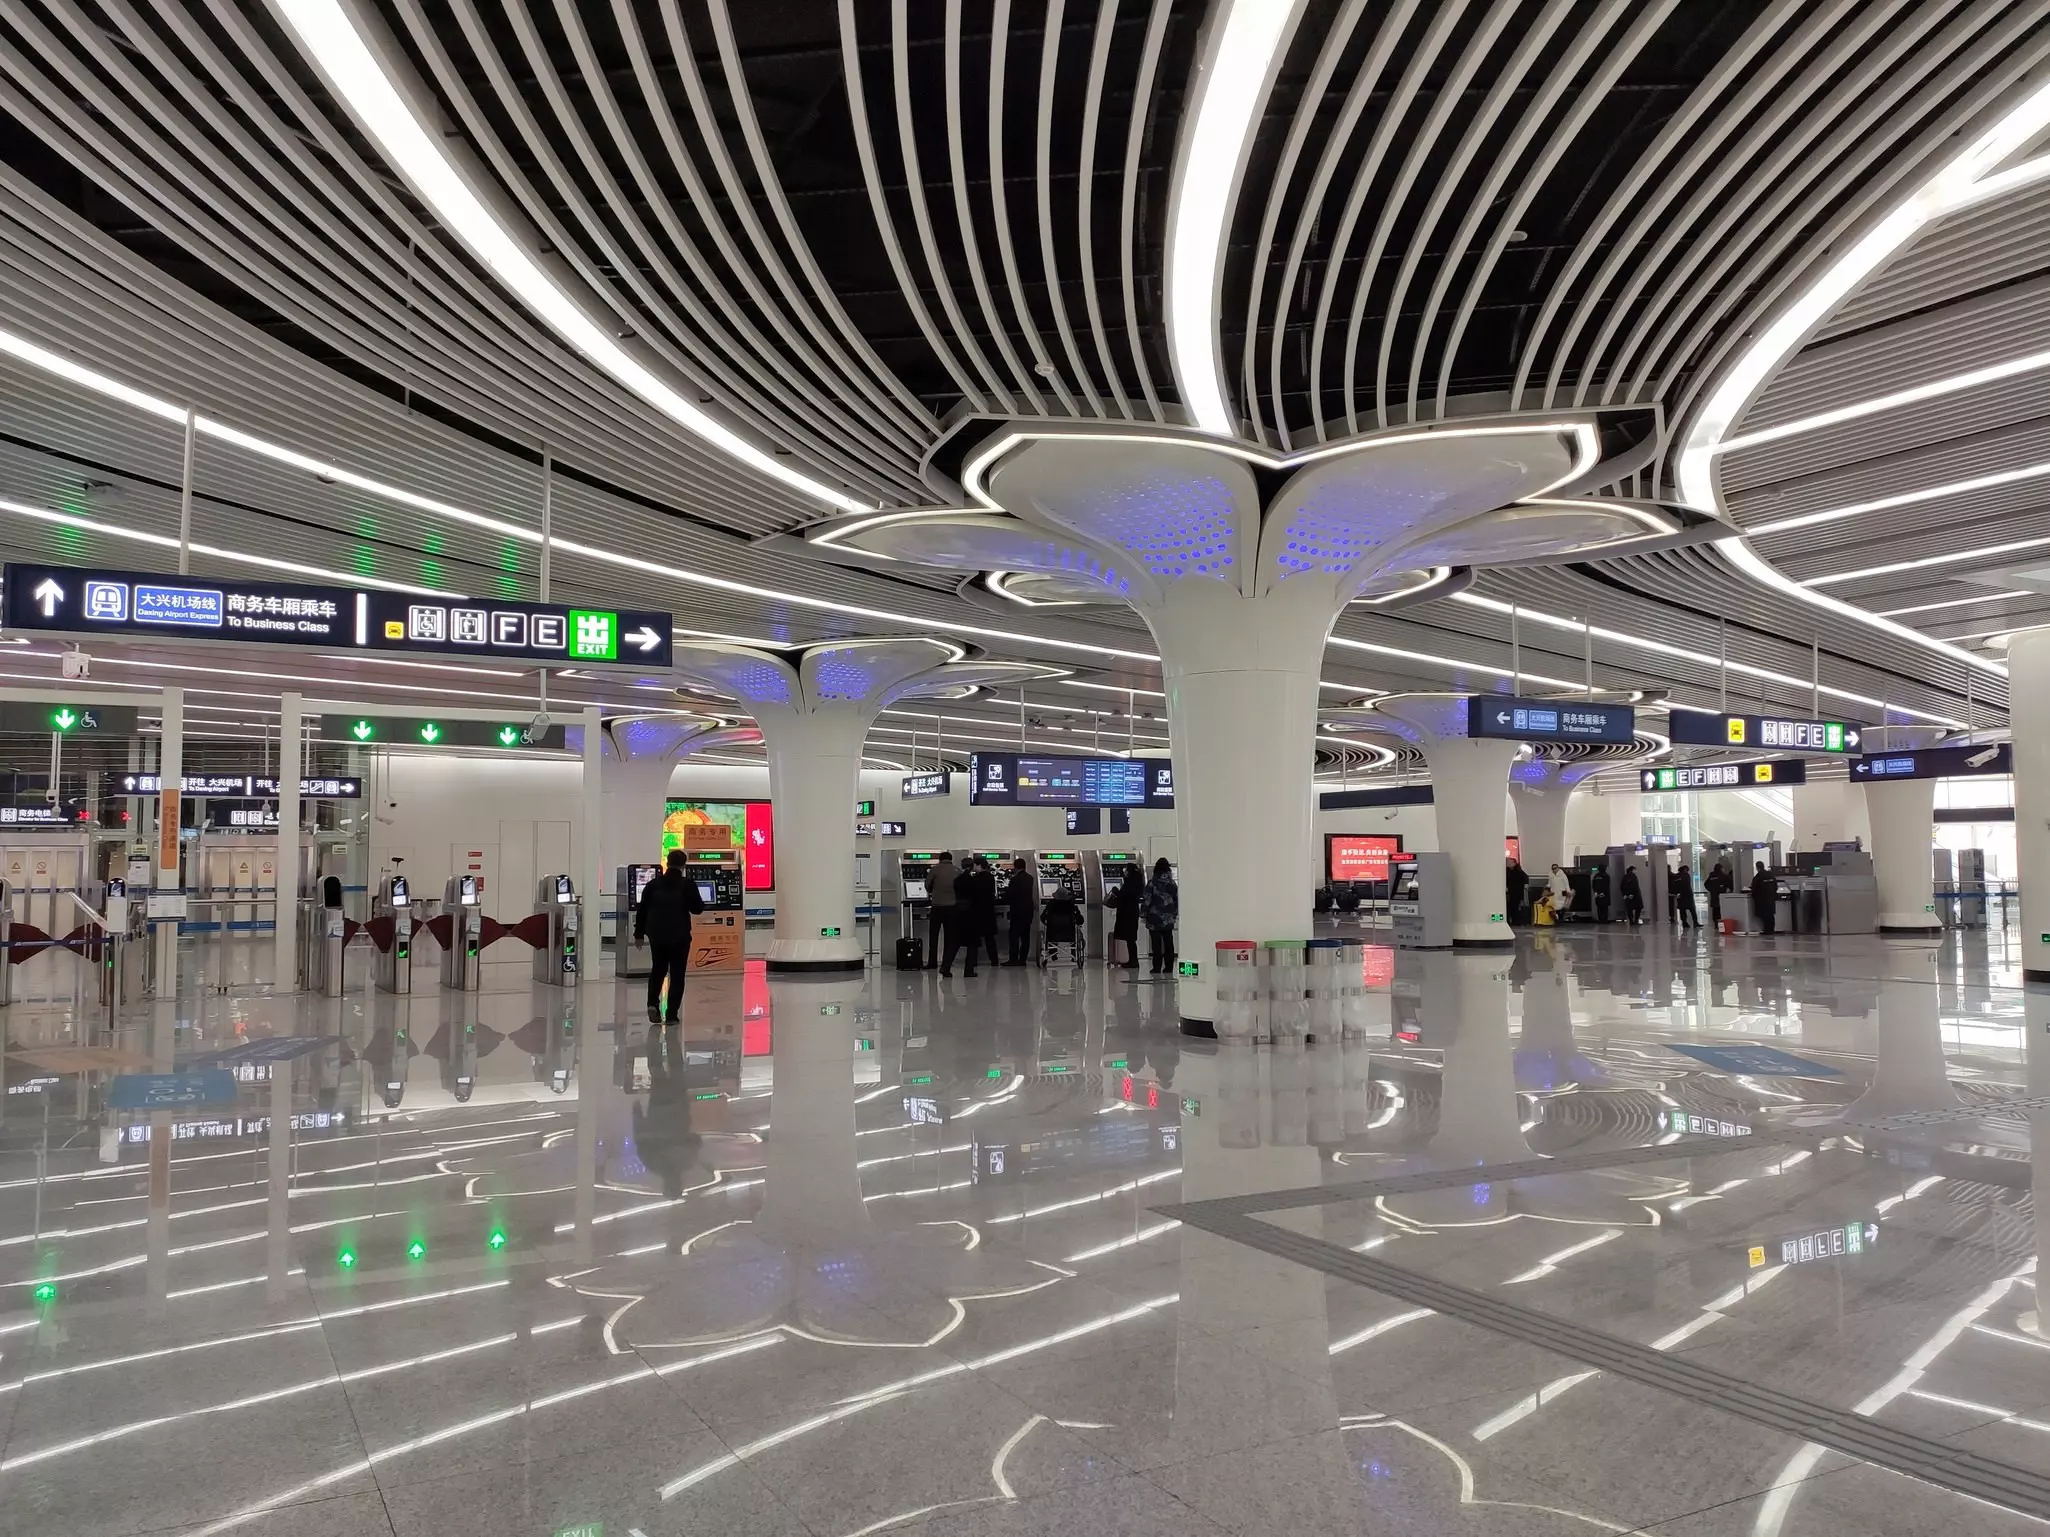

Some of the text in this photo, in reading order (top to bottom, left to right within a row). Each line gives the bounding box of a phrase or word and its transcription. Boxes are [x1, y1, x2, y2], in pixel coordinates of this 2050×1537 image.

[140, 592, 217, 611] 大兴机场线
[227, 593, 338, 619] 商务车厢乘车
[138, 608, 219, 621] Daxing Airport Express
[227, 615, 330, 633] To Business Class
[502, 616, 558, 644] F E
[577, 643, 608, 656] EXIT
[1562, 712, 1607, 726] 商务车厢乘车
[188, 777, 243, 787] 开往 大兴机场
[256, 779, 273, 788] 开往
